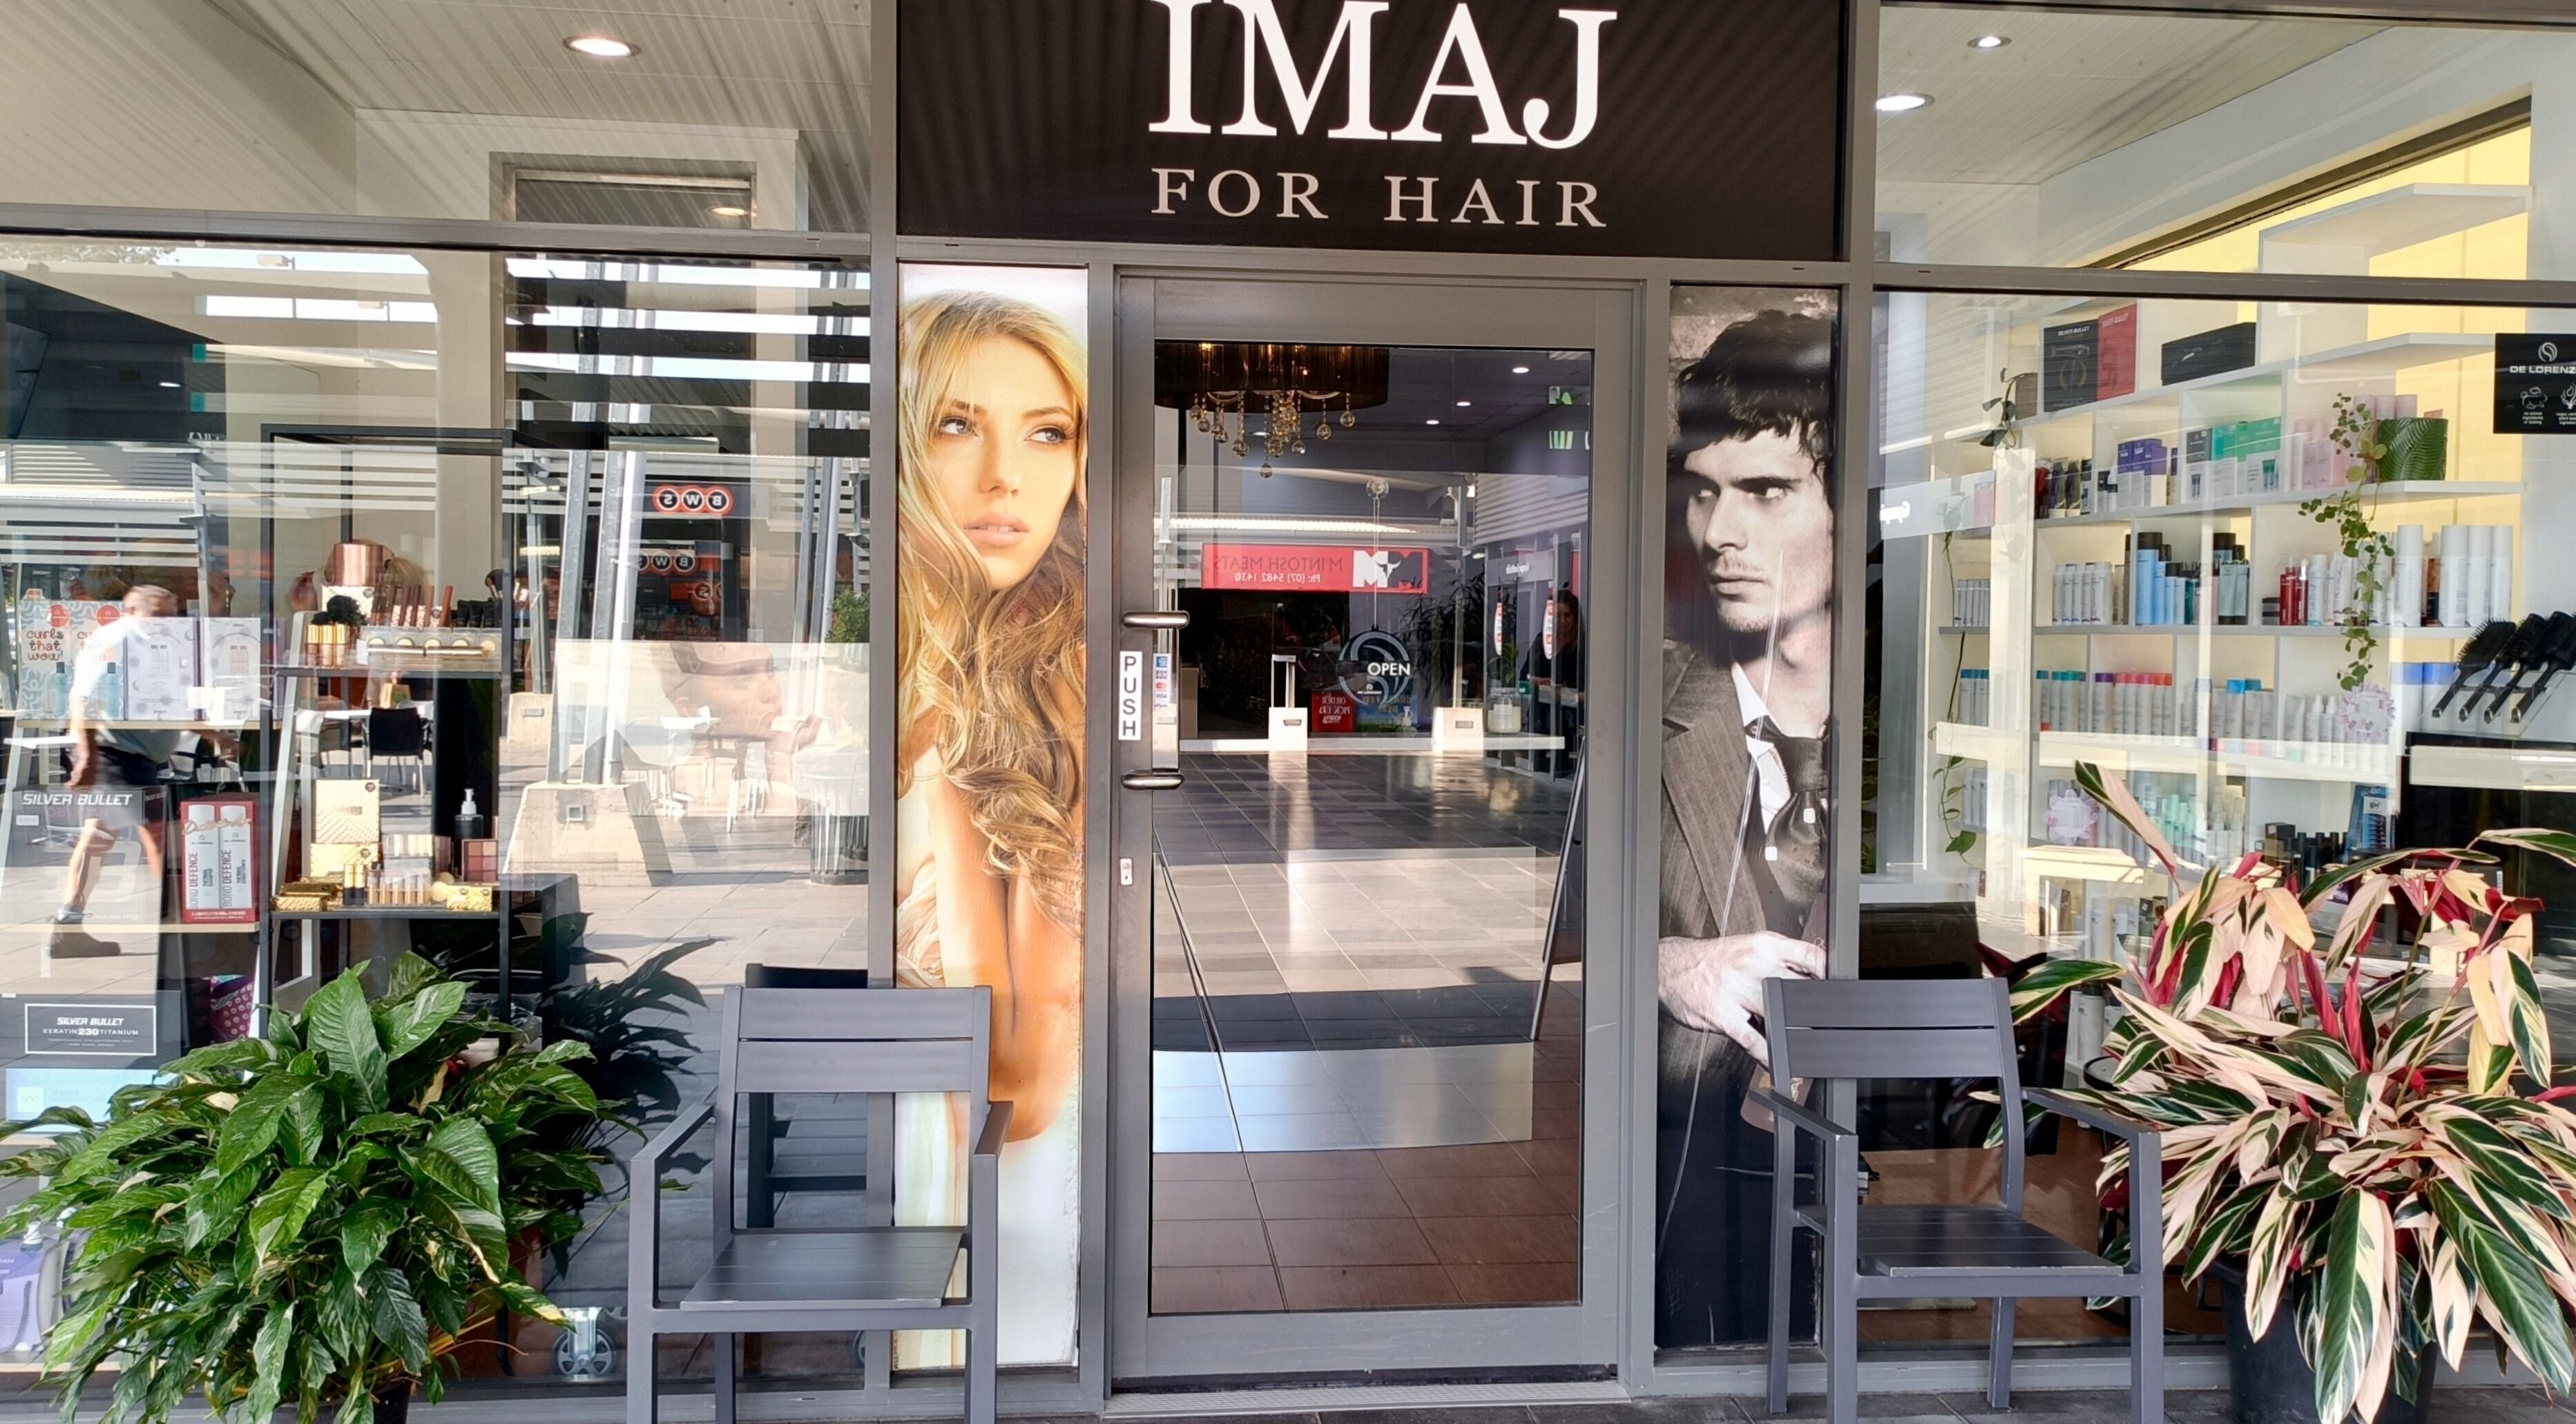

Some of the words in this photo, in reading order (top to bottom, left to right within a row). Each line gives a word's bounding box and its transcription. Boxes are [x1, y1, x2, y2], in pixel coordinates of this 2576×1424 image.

[1148, 0, 1618, 150] IMAJ
[1151, 167, 1329, 220] FOR
[1383, 175, 1607, 228] HAIR
[2509, 365, 2526, 374] DE
[26, 628, 64, 639] curls
[28, 640, 61, 651] that
[27, 651, 64, 662] wow!
[1367, 662, 1411, 676] OPEN
[1122, 655, 1137, 737] PUSH
[22, 793, 73, 805] SILVER
[77, 793, 133, 806] BULLET
[189, 851, 198, 887] DEFENCE
[221, 849, 232, 884] DEFENCE
[222, 885, 232, 907] BOND
[57, 1017, 88, 1026] SILVER
[90, 1017, 124, 1026] BULLET
[77, 1028, 99, 1036] 230
